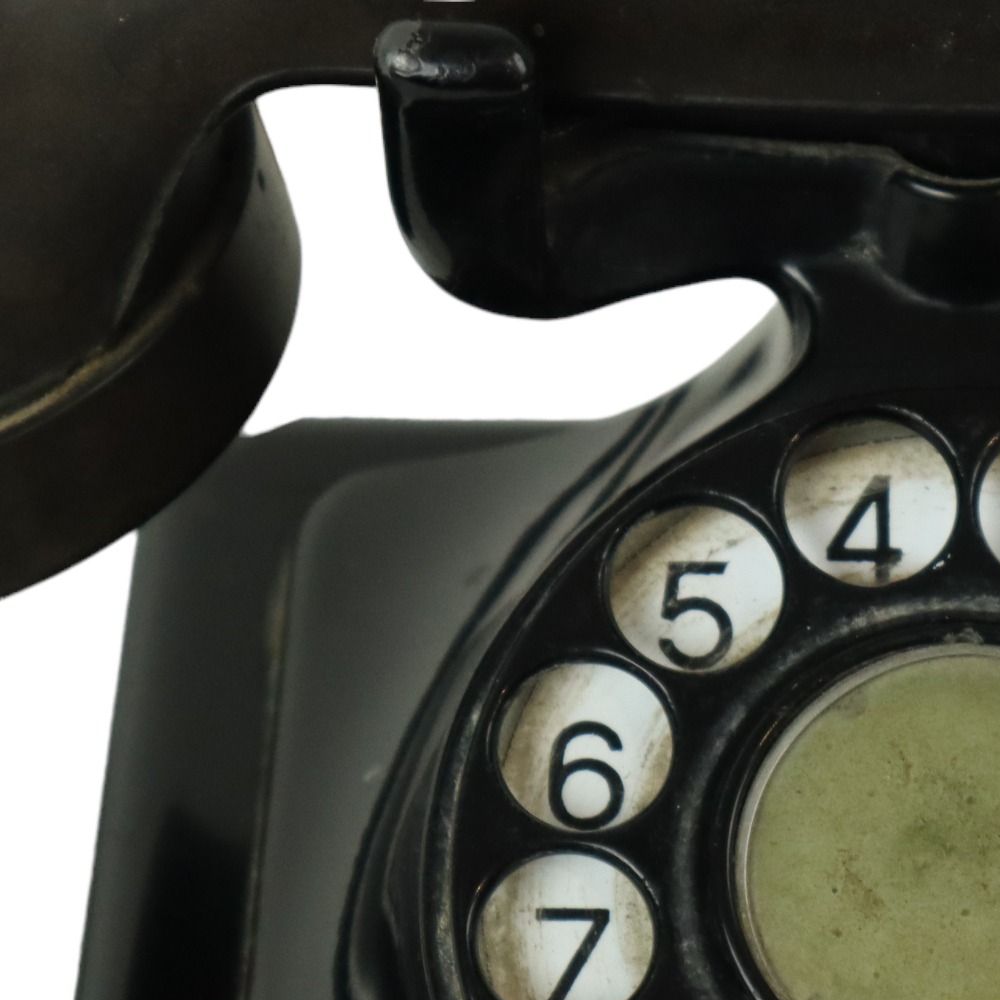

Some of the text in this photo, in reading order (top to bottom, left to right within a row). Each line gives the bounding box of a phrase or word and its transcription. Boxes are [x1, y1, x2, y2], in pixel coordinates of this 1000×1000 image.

[826, 475, 904, 580] 4
[657, 561, 734, 671] 5
[548, 720, 625, 831] 6
